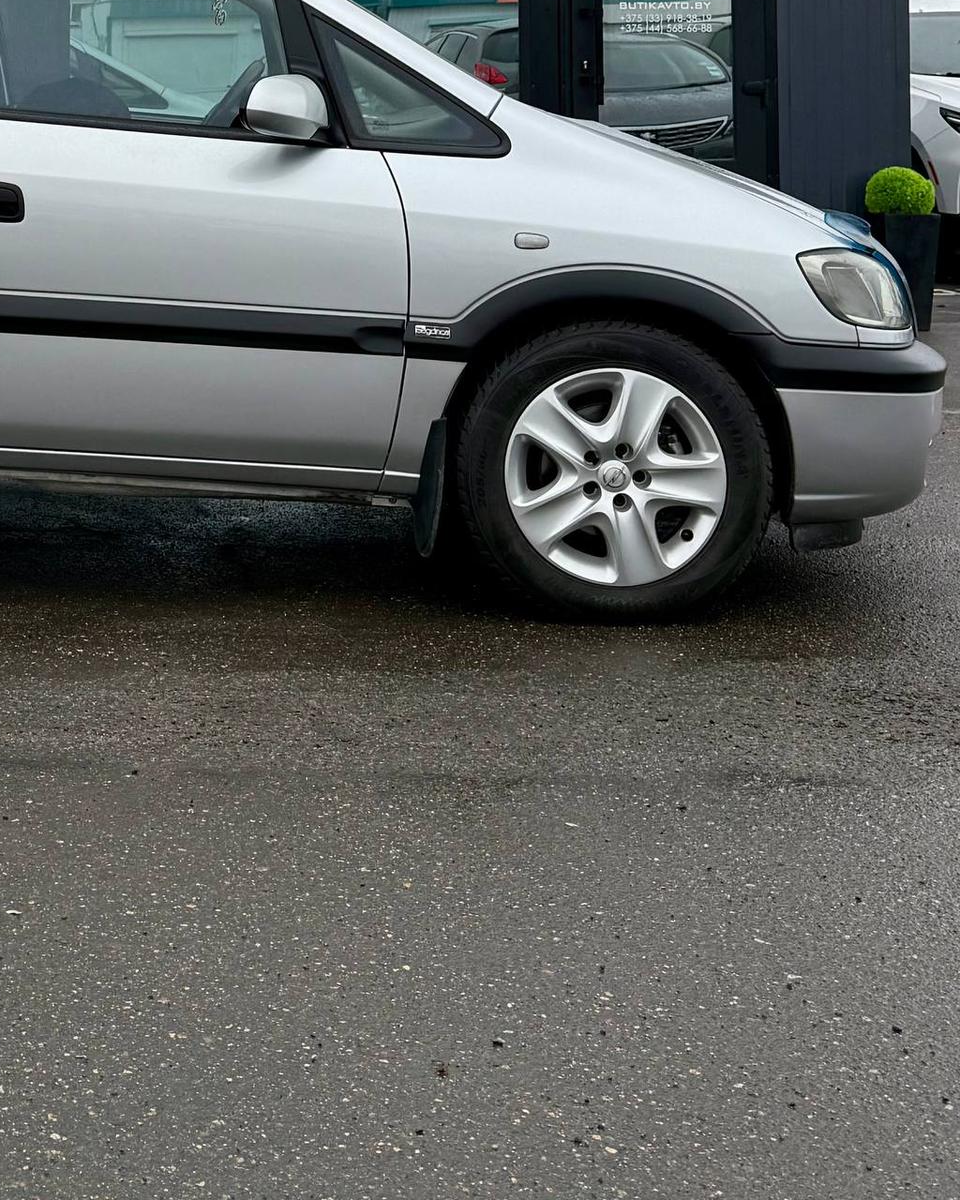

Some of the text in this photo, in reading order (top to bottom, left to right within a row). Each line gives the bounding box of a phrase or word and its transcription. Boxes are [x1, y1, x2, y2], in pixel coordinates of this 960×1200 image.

[619, 1, 711, 10] BUTIKAVTO.BY
[620, 13, 643, 22] +375
[646, 13, 663, 23] (33)
[620, 23, 712, 34] +375 (44) 568-66-88
